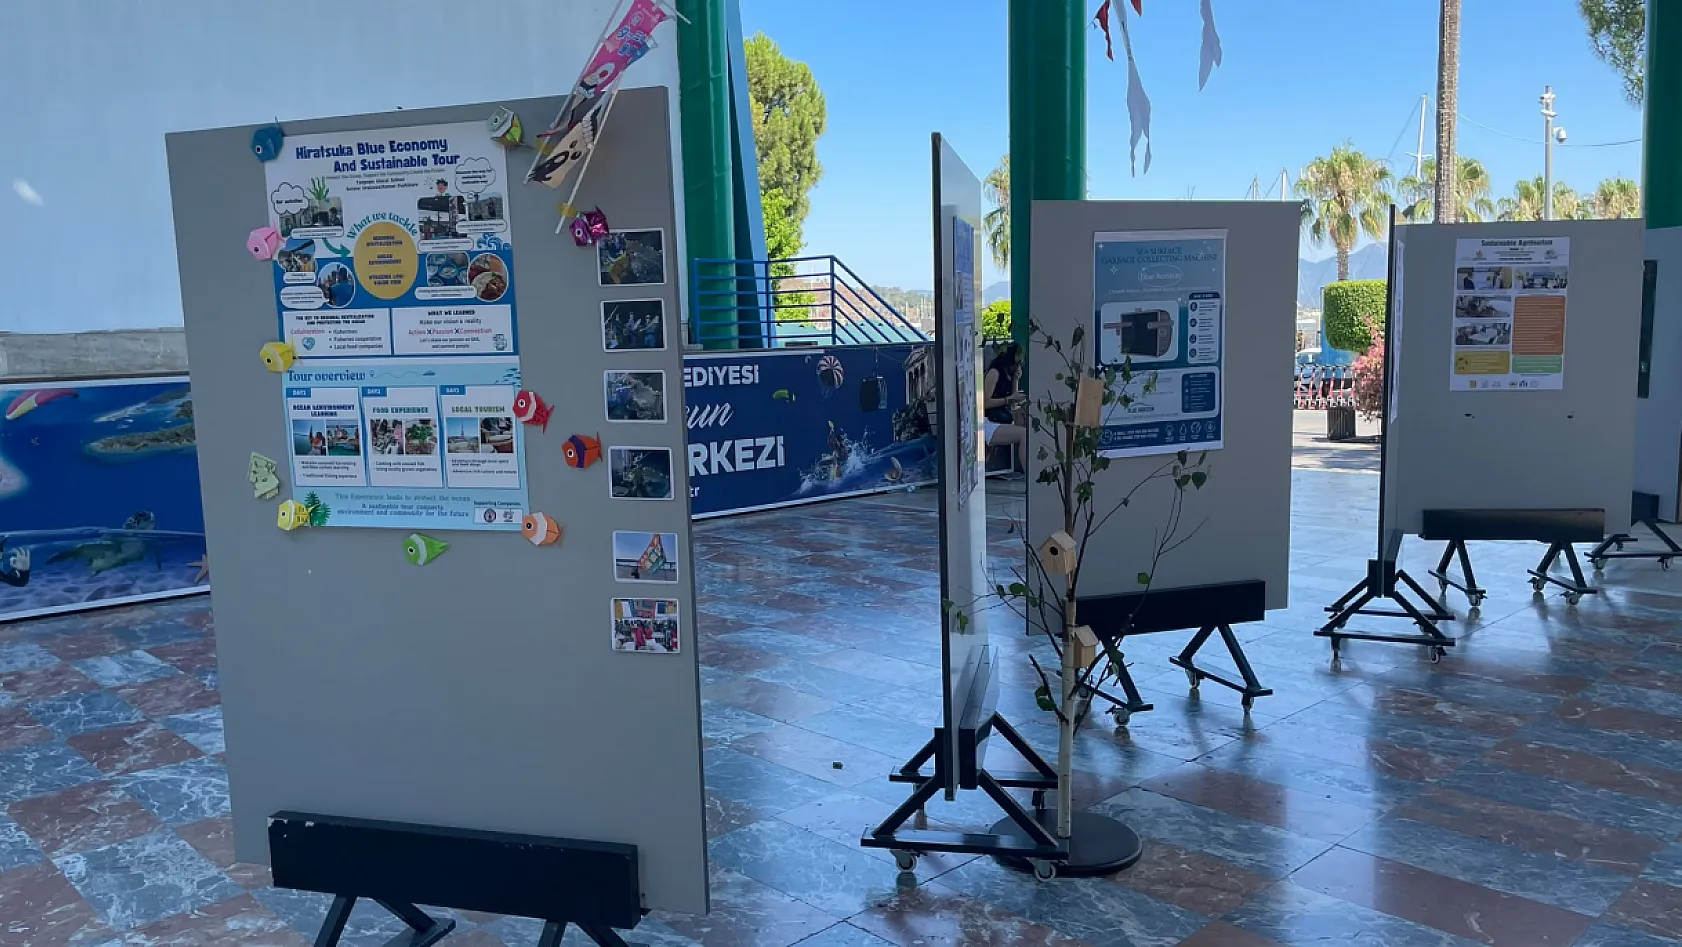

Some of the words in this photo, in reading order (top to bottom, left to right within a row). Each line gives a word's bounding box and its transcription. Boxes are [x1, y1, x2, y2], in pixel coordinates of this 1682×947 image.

[296, 144, 353, 160] Hiratsuka
[357, 142, 385, 155] Blue
[389, 139, 448, 153] Economy
[334, 160, 356, 173] And
[360, 155, 428, 171] Sustainable
[432, 154, 460, 166] Tour
[347, 216, 371, 239] What
[372, 212, 387, 220] we
[389, 212, 418, 237] tackle
[1136, 255, 1183, 263] COLLECTING
[287, 369, 314, 382] Tour
[314, 369, 366, 381] overview
[373, 406, 389, 414] FOOD
[451, 405, 472, 413] LOCAL
